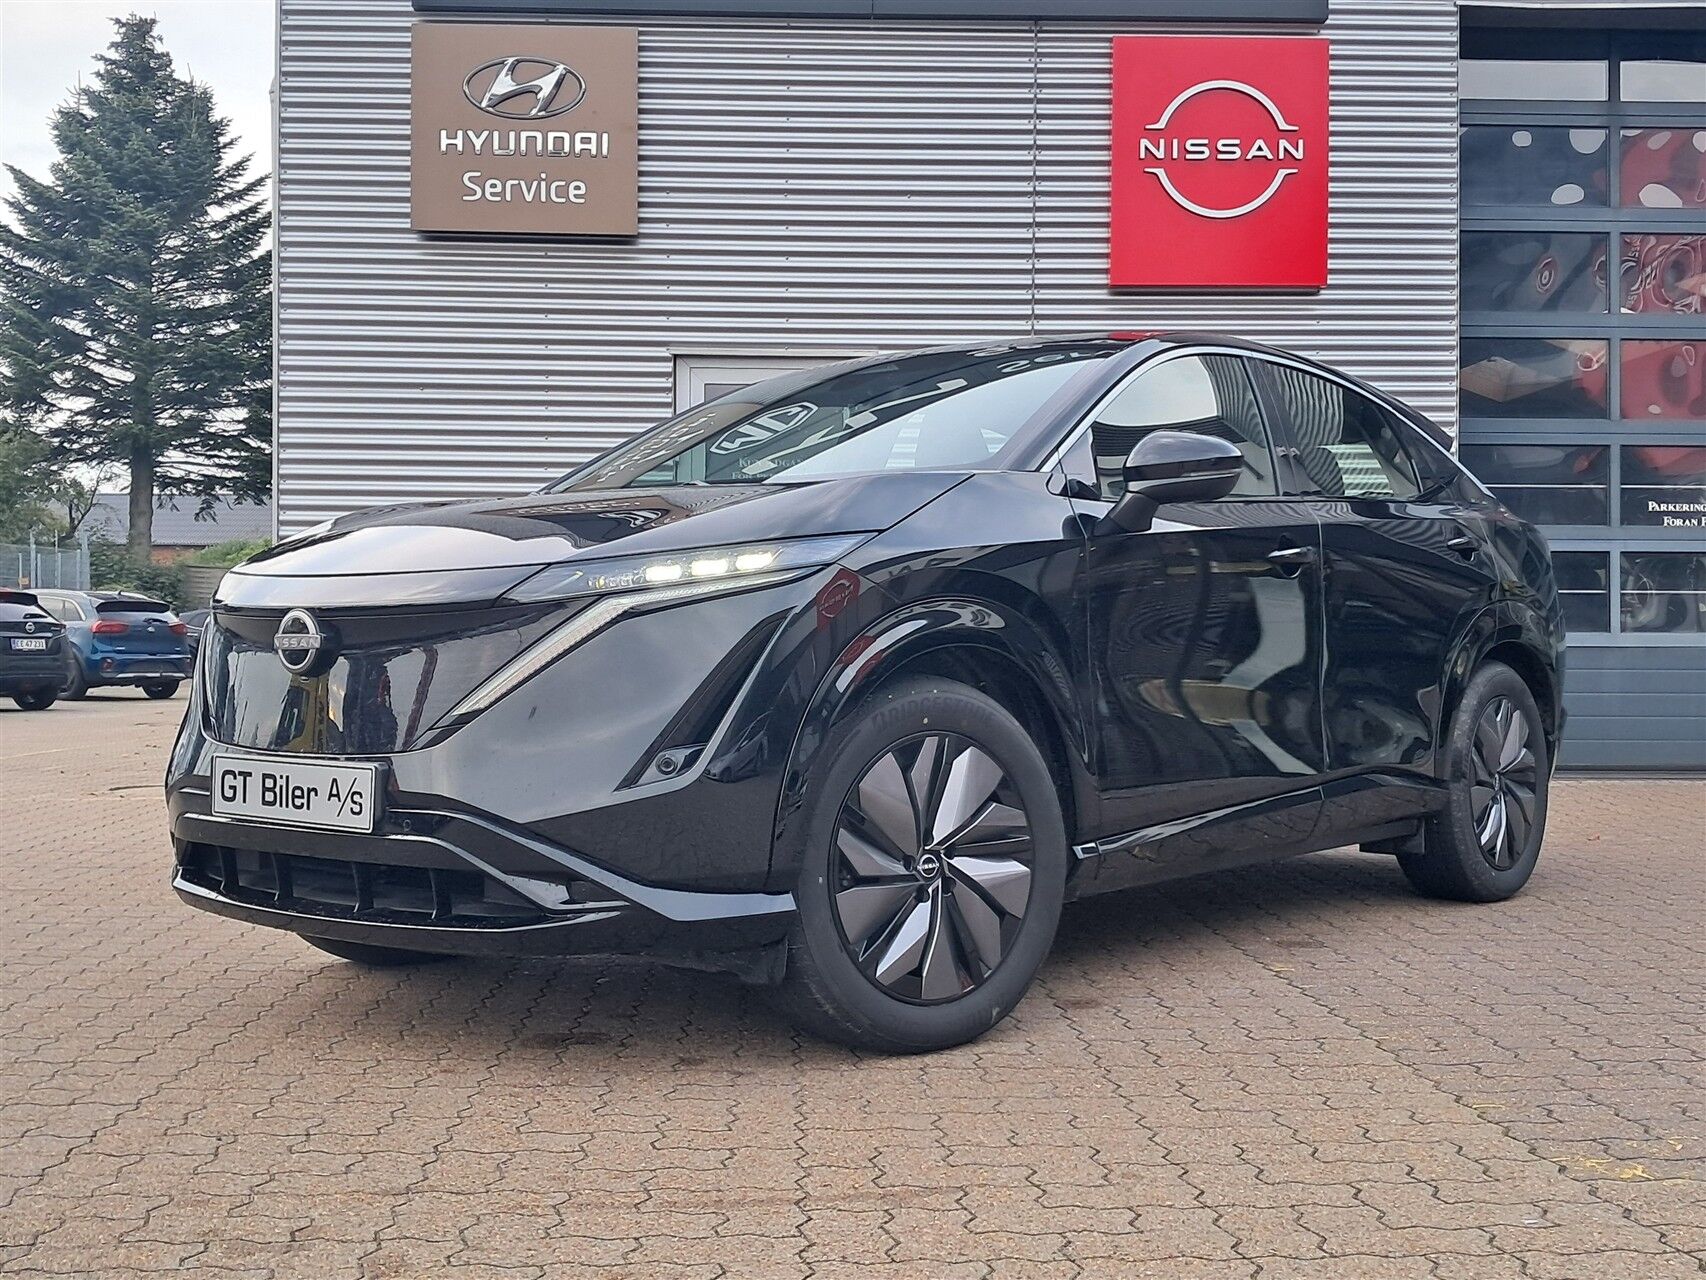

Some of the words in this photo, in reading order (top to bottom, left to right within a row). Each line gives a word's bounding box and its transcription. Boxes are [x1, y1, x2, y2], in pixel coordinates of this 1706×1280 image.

[439, 129, 610, 158] HYUNDAI
[1139, 138, 1304, 160] NISSAN
[462, 170, 587, 204] Service
[1648, 501, 1706, 512] PARKERING
[1663, 516, 1698, 527] FORAN
[220, 769, 252, 804] GT
[261, 773, 319, 811] Biler
